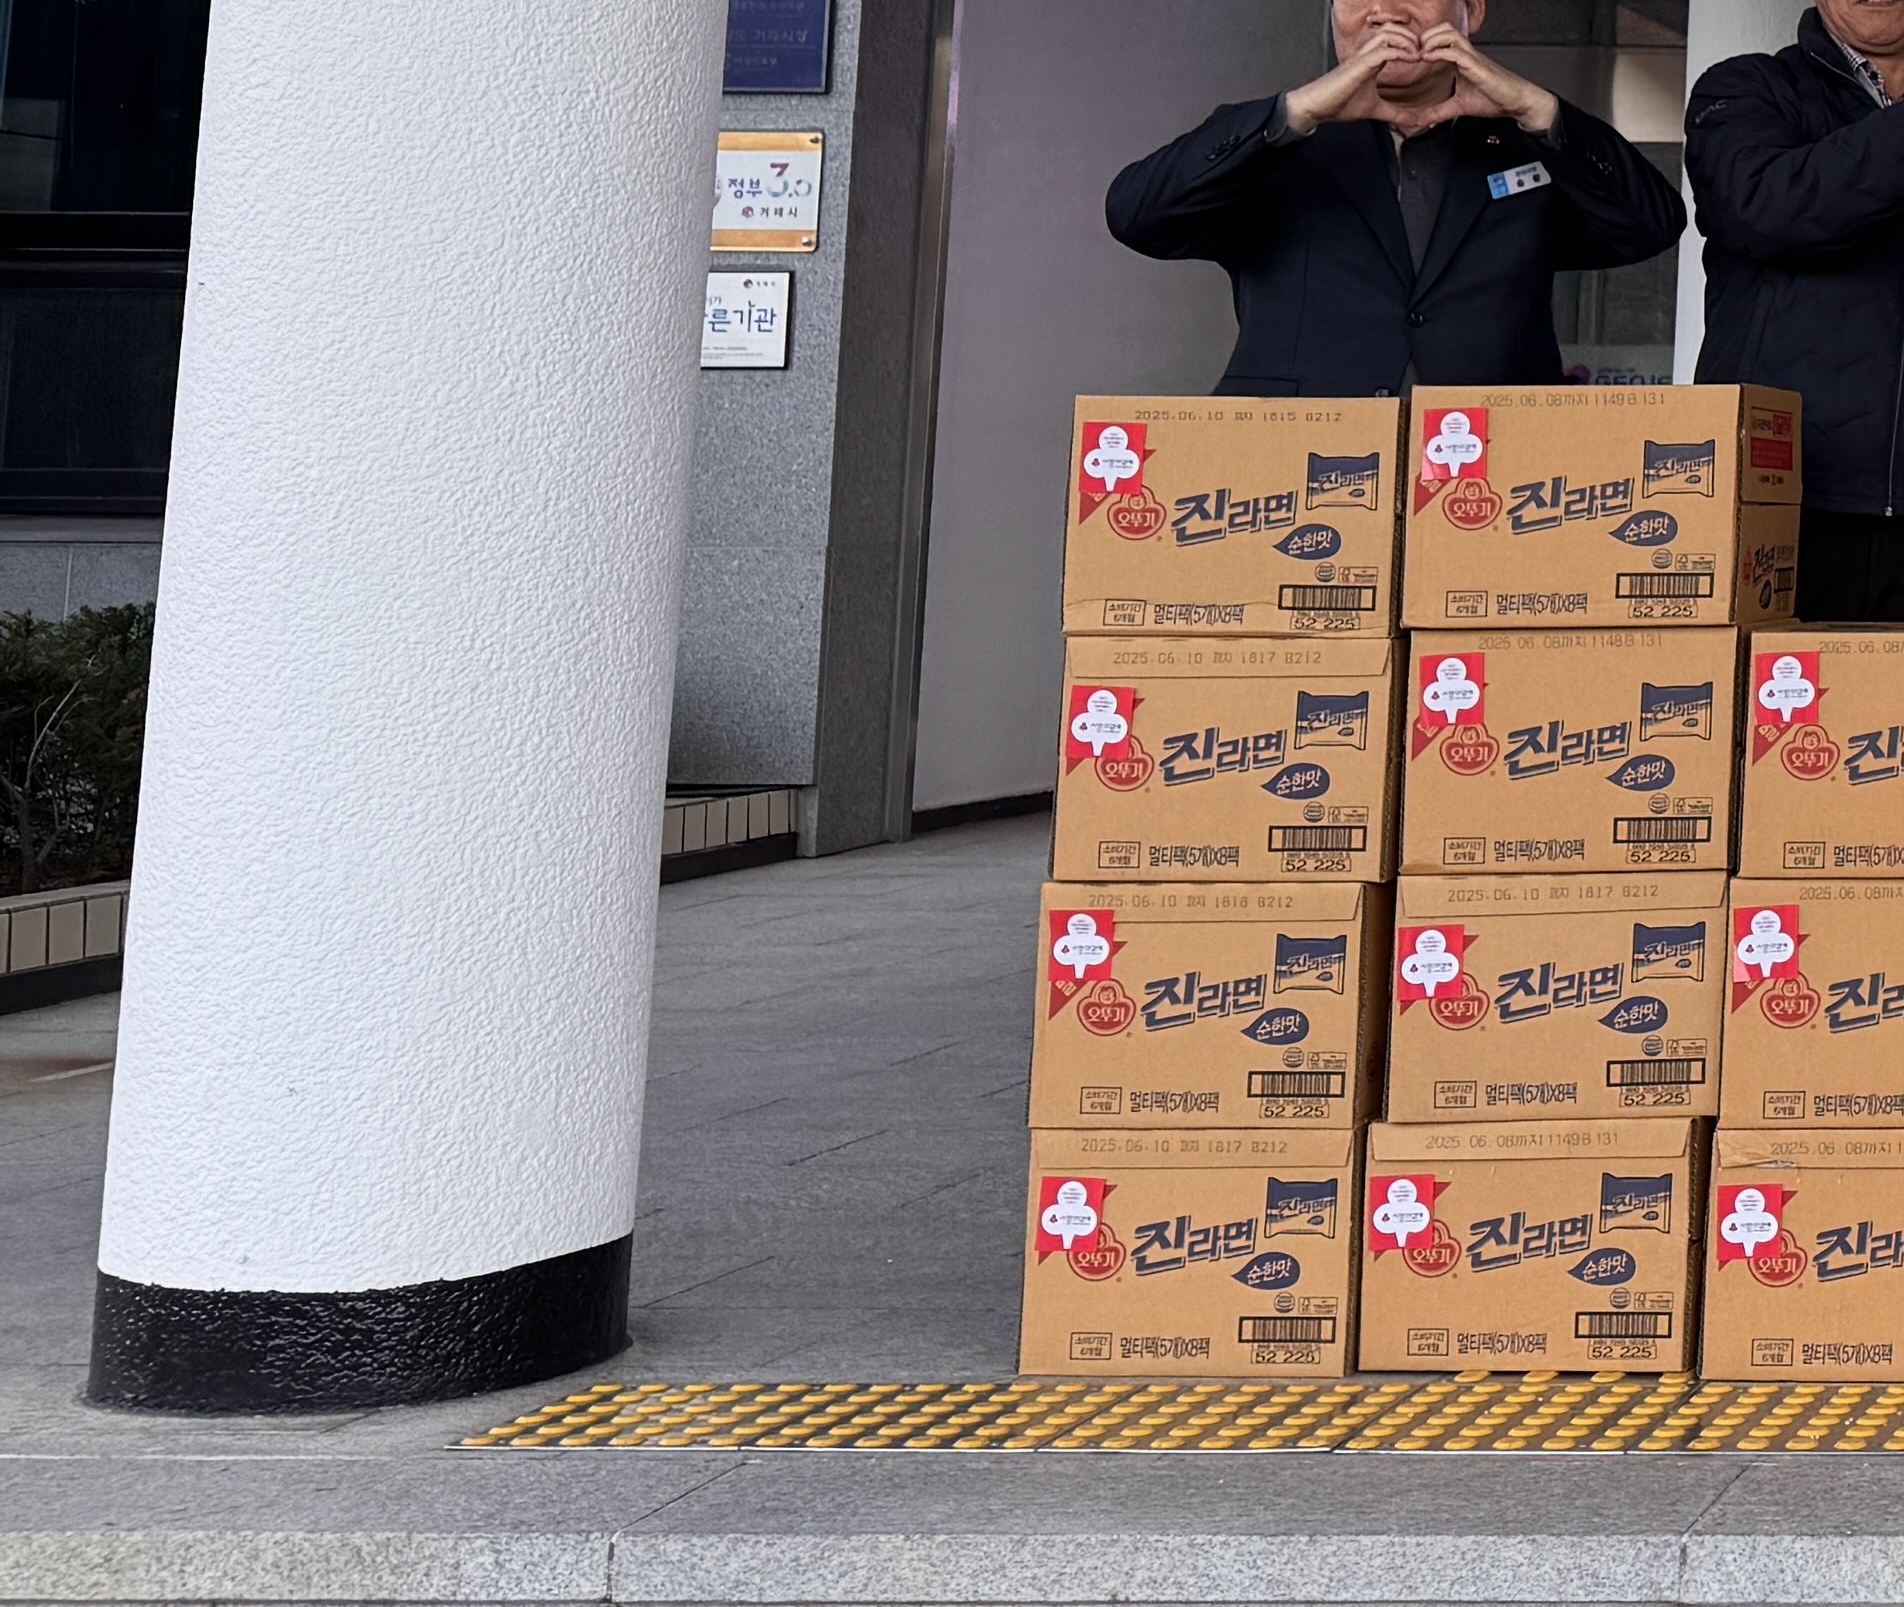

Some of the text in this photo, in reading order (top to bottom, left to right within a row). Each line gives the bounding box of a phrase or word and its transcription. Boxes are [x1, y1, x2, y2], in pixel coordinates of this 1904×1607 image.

[728, 163, 812, 199] 정부 3.0
[705, 300, 777, 332] 른기관
[1170, 488, 1298, 546] 진라면
[1453, 501, 1491, 518] 오뚜기
[1506, 475, 1635, 535] 진라면
[1118, 512, 1155, 527] 오뚜기
[1624, 517, 1669, 543] 순한맛
[1287, 530, 1333, 555] 순한맛
[1159, 727, 1287, 787] 진라면
[1450, 746, 1488, 763] 오뚜기
[1503, 719, 1632, 780] 진라면
[1791, 751, 1829, 767] 오뚜기
[1277, 769, 1321, 795] 순한맛
[1622, 761, 1666, 787] 순한맛
[1631, 850, 1691, 863] 52 225
[1141, 971, 1267, 1032] 진라면
[1494, 961, 1624, 1023] 진라면
[1089, 1006, 1125, 1021] 오뚜기
[1440, 1000, 1478, 1015] 오뚜기
[1614, 1003, 1659, 1029] 순한맛
[1771, 998, 1809, 1015] 오뚜기
[1256, 1014, 1301, 1041] 순한맛
[1131, 1215, 1258, 1277] 진라면
[1466, 1211, 1593, 1273] 진라면
[1413, 1248, 1450, 1263] 오뚜기
[1583, 1254, 1627, 1281] 순한맛
[1759, 1258, 1796, 1273] 오뚜기
[1247, 1259, 1291, 1285] 순한맛
